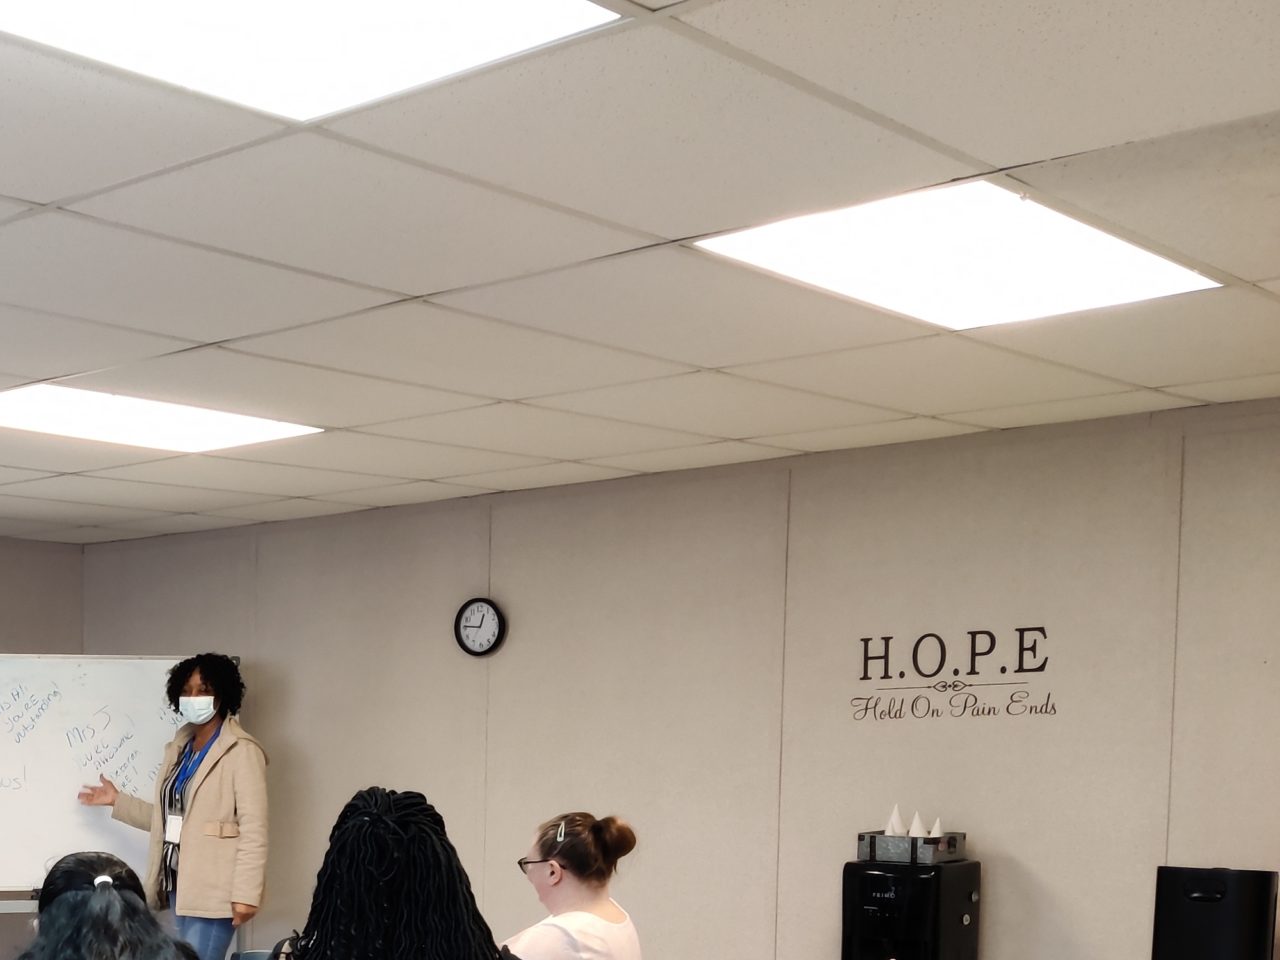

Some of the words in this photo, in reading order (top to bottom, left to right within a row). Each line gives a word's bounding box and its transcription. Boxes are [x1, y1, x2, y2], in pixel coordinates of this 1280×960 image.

[859, 626, 1048, 680] H.O.P.E
[850, 696, 905, 721] Hold
[910, 694, 943, 718] On
[949, 692, 1000, 718] Pain
[1006, 690, 1057, 716] Ends
